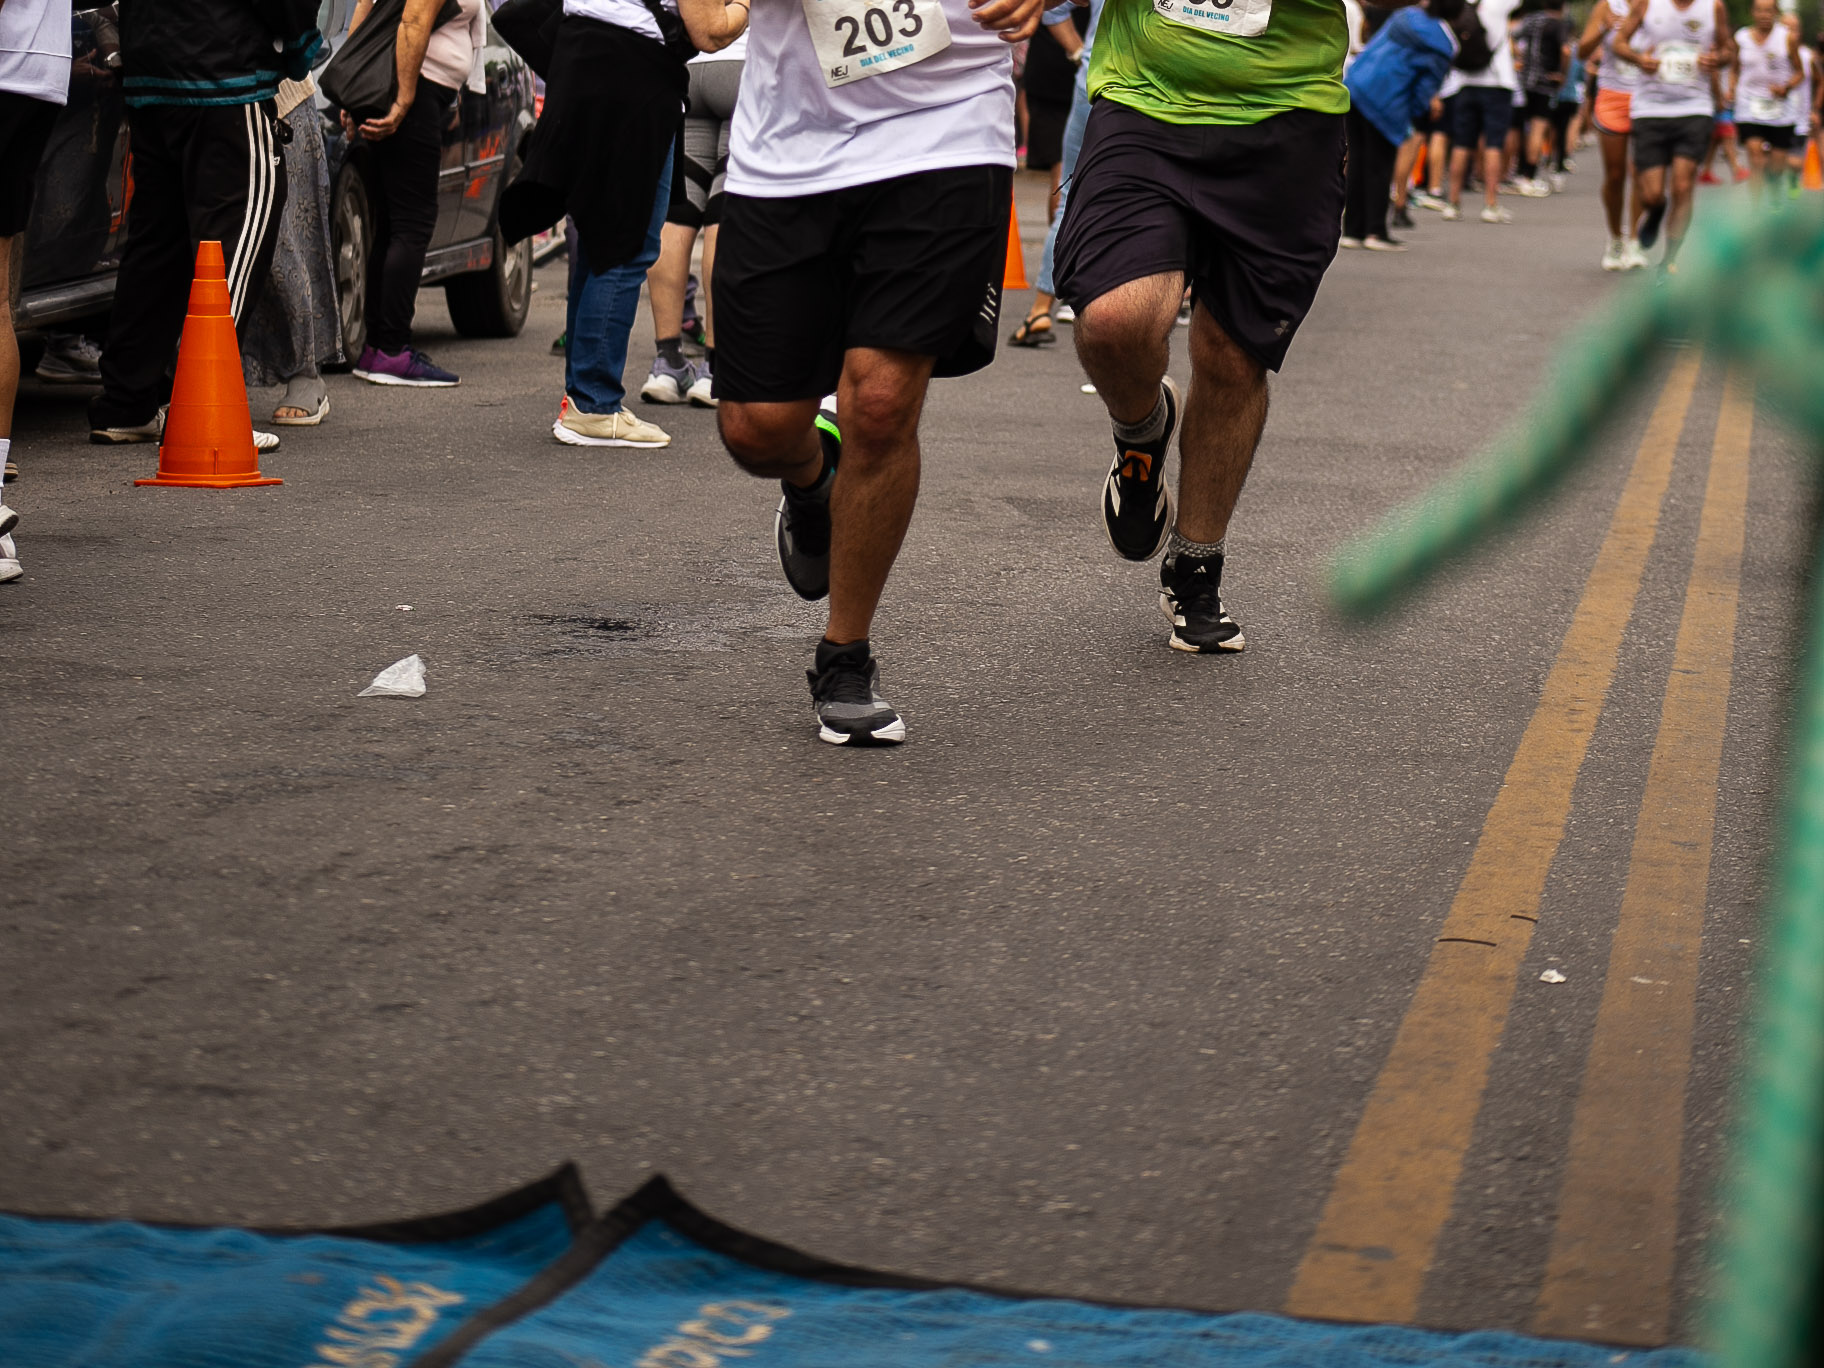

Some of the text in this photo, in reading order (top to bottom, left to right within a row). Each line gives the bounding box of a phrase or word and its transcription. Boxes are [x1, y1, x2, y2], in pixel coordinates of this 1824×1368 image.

[1182, 5, 1193, 15] DIA
[1193, 9, 1205, 18] DEL
[1206, 11, 1230, 22] VECINO
[859, 44, 915, 68] DIA DEL VECINO
[830, 65, 849, 79] NEJ
